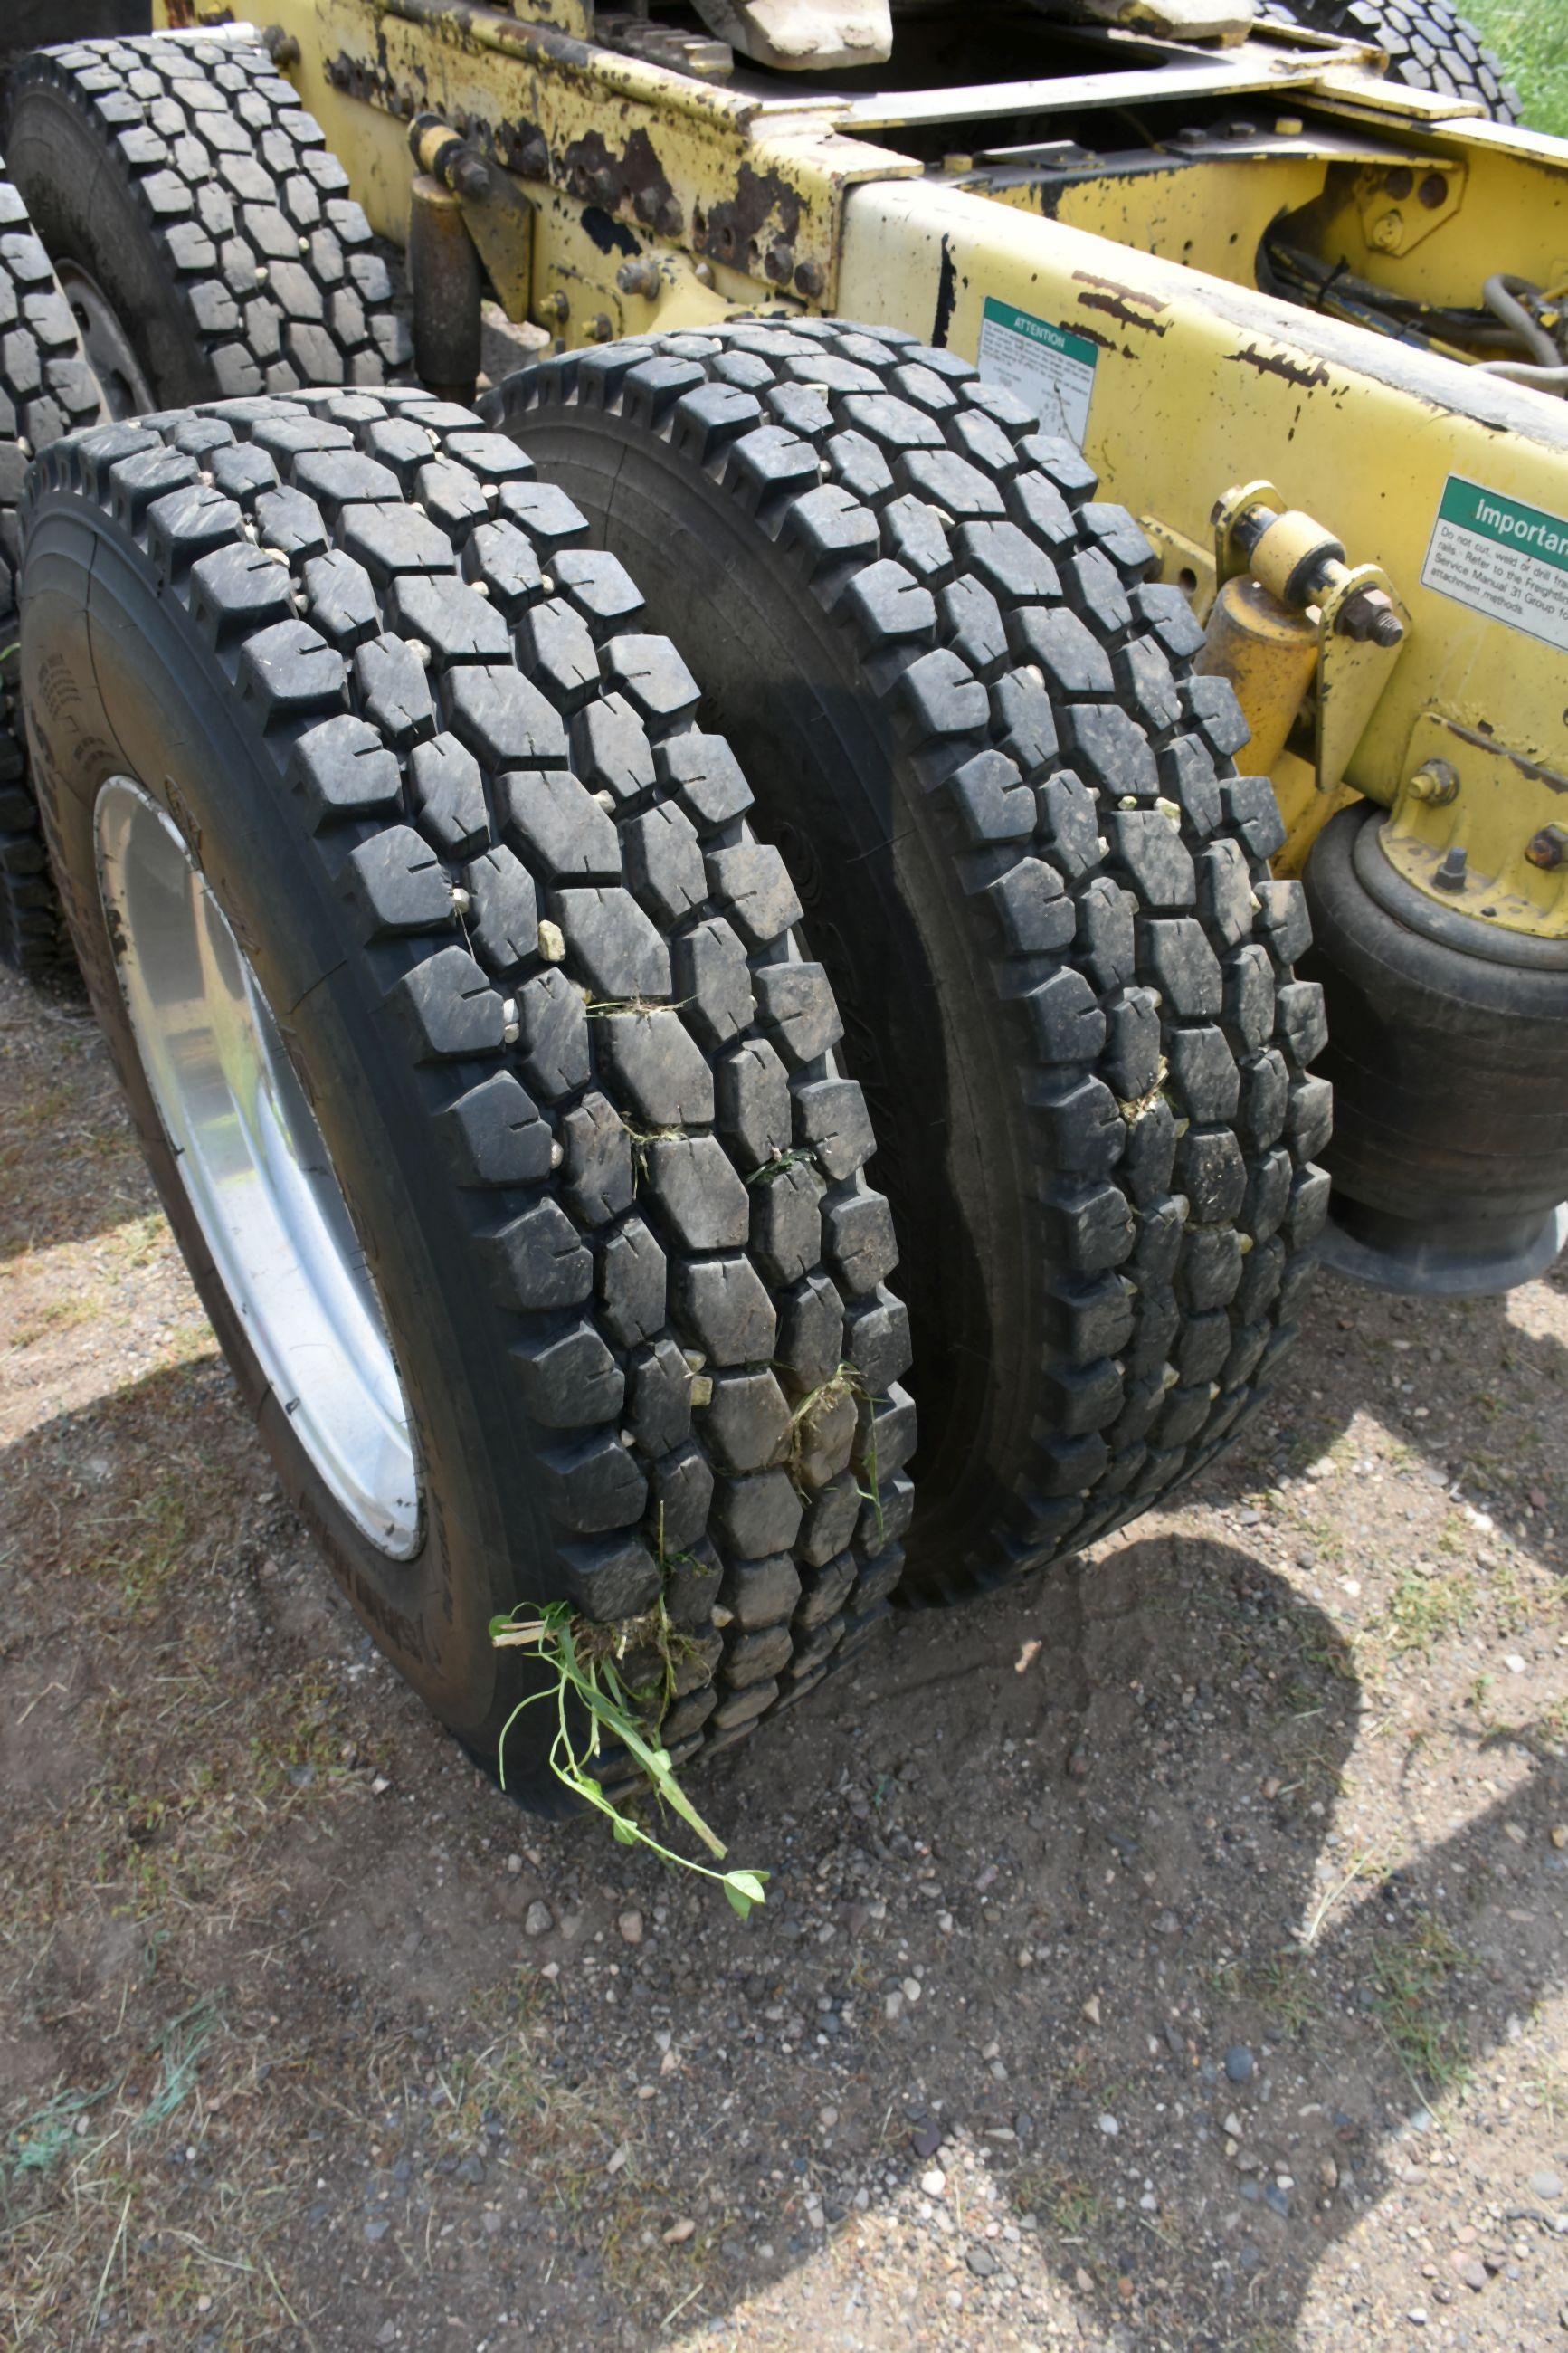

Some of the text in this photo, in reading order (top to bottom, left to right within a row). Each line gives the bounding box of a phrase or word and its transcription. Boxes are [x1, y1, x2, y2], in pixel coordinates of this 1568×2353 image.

[1013, 317, 1066, 349] ATTENTION
[1440, 526, 1454, 539] Do
[1457, 535, 1472, 548] not
[1495, 552, 1519, 567] weld
[1520, 561, 1530, 572] or
[1533, 567, 1552, 581] drill
[1465, 551, 1490, 568] Refer
[1493, 565, 1504, 576] to
[1506, 569, 1522, 585] the
[1430, 567, 1481, 595] attachment
[1434, 552, 1469, 575] Service
[1472, 569, 1508, 592] Manual
[1510, 586, 1522, 599] 31
[1524, 593, 1555, 614] Group
